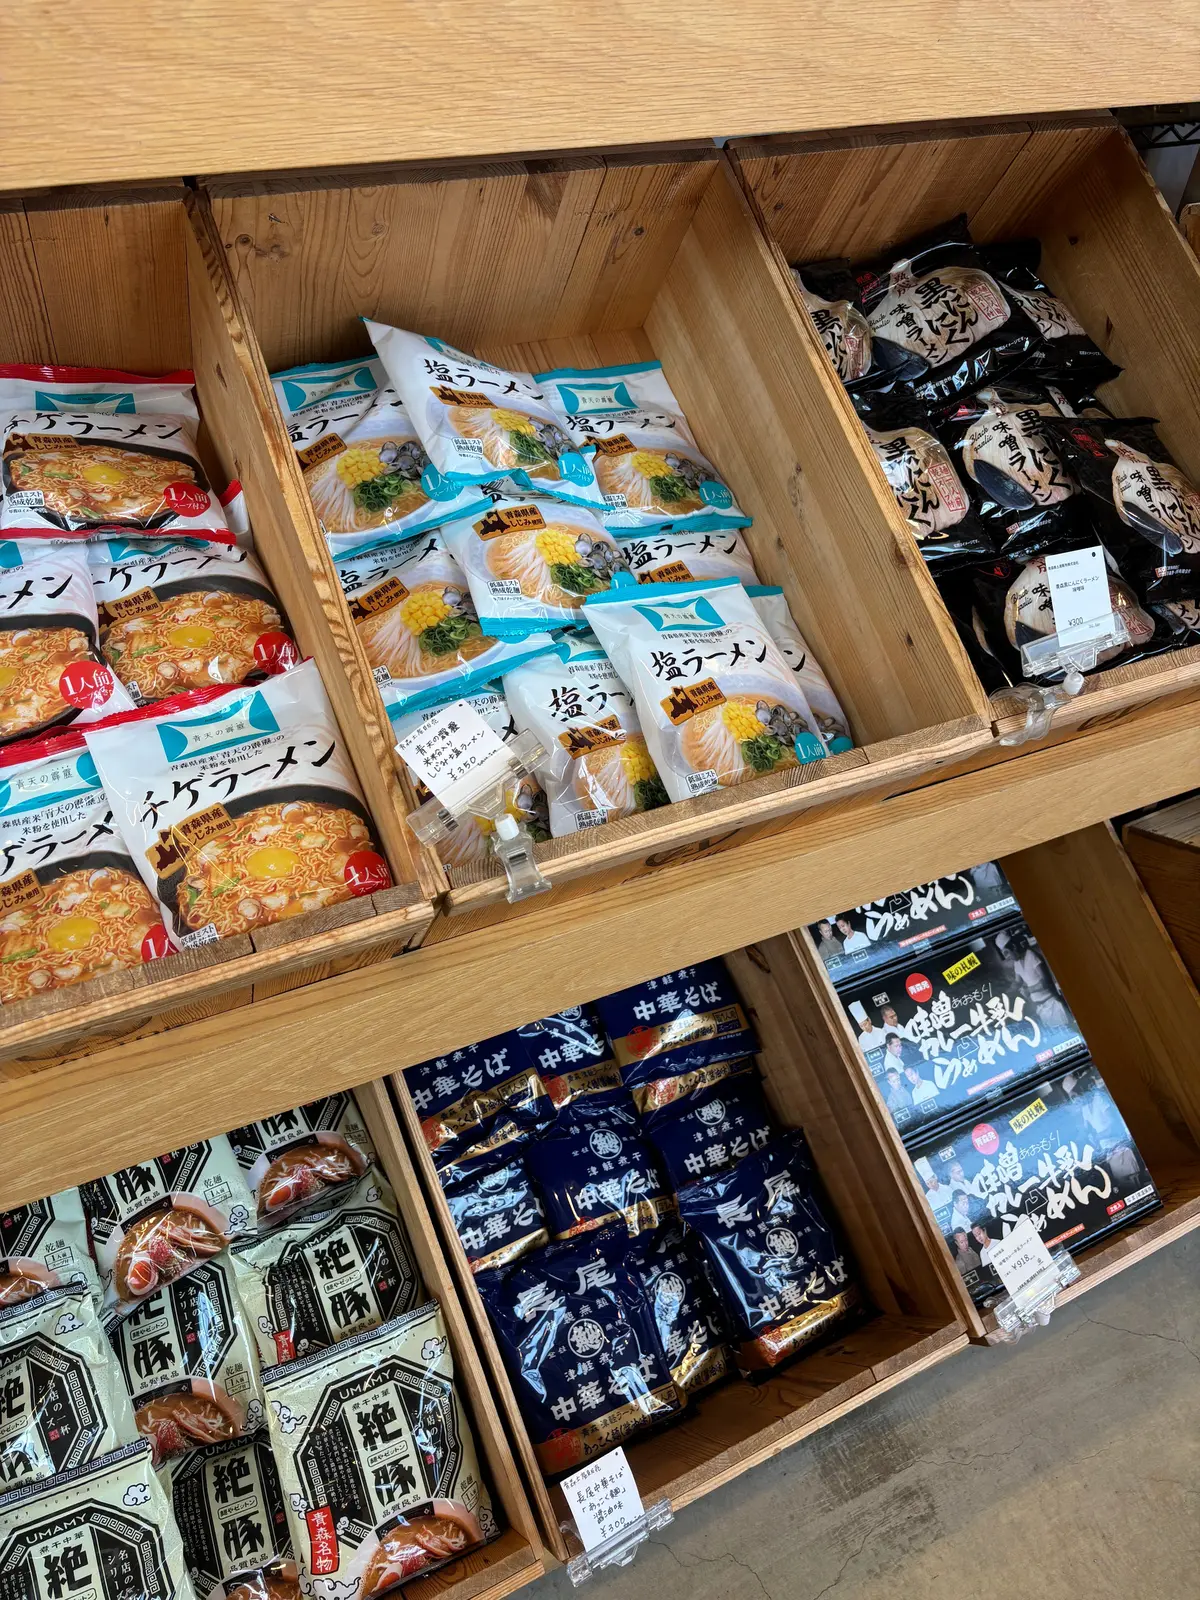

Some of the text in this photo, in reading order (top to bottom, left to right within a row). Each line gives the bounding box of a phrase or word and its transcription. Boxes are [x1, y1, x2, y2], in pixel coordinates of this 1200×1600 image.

[889, 303, 948, 364] 味噌ラーメン
[424, 358, 545, 400] 塩ラーメン
[968, 425, 990, 447] Black
[992, 420, 1052, 504] 味噌ラーメン
[166, 487, 208, 504] 1人前
[504, 505, 540, 521] 青森県産
[509, 516, 543, 528] しじみ使用
[623, 534, 737, 570] 塩ラーメン
[488, 579, 519, 590] 低温ミスト
[656, 564, 686, 579] 青森県産
[112, 589, 152, 611] 青森県産
[365, 579, 399, 606] 青森県産
[370, 589, 406, 612] しじみ使用
[490, 586, 521, 596] 熟成乾麺
[117, 602, 159, 618] しじみ使用
[1067, 616, 1084, 627] ¥300
[651, 639, 767, 682] 塩ラーメン
[63, 670, 111, 697] 1人前
[689, 681, 716, 698] 青森県産
[696, 692, 723, 706] しじみ使用
[797, 741, 825, 760] 1人前
[140, 740, 336, 830] チゲラーメン
[688, 771, 716, 784] 低温ミスト
[22, 811, 87, 836] 米粉を使用した
[180, 808, 225, 836] 青森県産
[576, 811, 607, 821] 低温ミスト
[647, 967, 697, 991] 津軽煮干
[945, 955, 979, 984] 味の札幌
[632, 980, 722, 1022] 中華そば
[908, 981, 930, 995] 青森発
[903, 989, 956, 1044] 味噌
[918, 992, 1027, 1061] カレー牛乳
[420, 1043, 480, 1077] 津軽煮干
[411, 1048, 511, 1112] 中華そば
[692, 1115, 746, 1144] 津軽煮干
[1012, 1100, 1047, 1133] 味の札幌
[269, 1129, 305, 1147] 品質良品
[683, 1125, 772, 1176] 中華そば
[587, 1151, 643, 1177] 津軽煮干
[971, 1140, 1023, 1200] 味噌
[203, 1173, 223, 1188] 乾麺
[985, 1140, 1096, 1218] カレー牛乳
[126, 1190, 162, 1216] 品質良品
[44, 1239, 65, 1253] 乾麺
[50, 1251, 69, 1262] 1人前
[314, 1238, 356, 1281] 絶
[1011, 1253, 1031, 1271] ¥918
[178, 1290, 194, 1333] シリーズ
[328, 1281, 373, 1330] 豚
[340, 1318, 377, 1340] 品質良品
[133, 1331, 178, 1380] 豚
[139, 1370, 180, 1391] 品質良品
[225, 1362, 245, 1377] 乾麺
[339, 1368, 394, 1400] UMAMY
[47, 1378, 72, 1437] 名店の一杯
[351, 1389, 391, 1412] 煮干中華
[355, 1400, 403, 1452] 絶
[580, 1424, 599, 1438] 青森
[205, 1431, 257, 1456] UMAMY
[368, 1442, 407, 1466] 麺やゼットン
[213, 1454, 255, 1505] 絶
[267, 1466, 285, 1512] シリーズ
[371, 1454, 417, 1507] 豚
[218, 1497, 258, 1519] 麺やゼットン
[382, 1494, 422, 1519] 品質良品
[25, 1513, 87, 1544] UMAMY
[220, 1510, 265, 1563] 豚
[600, 1517, 626, 1539] ¥300
[39, 1530, 85, 1556] 煮干中華
[310, 1511, 336, 1572] 青森名物
[44, 1542, 92, 1594] 絶
[229, 1553, 269, 1574] 品質良品
